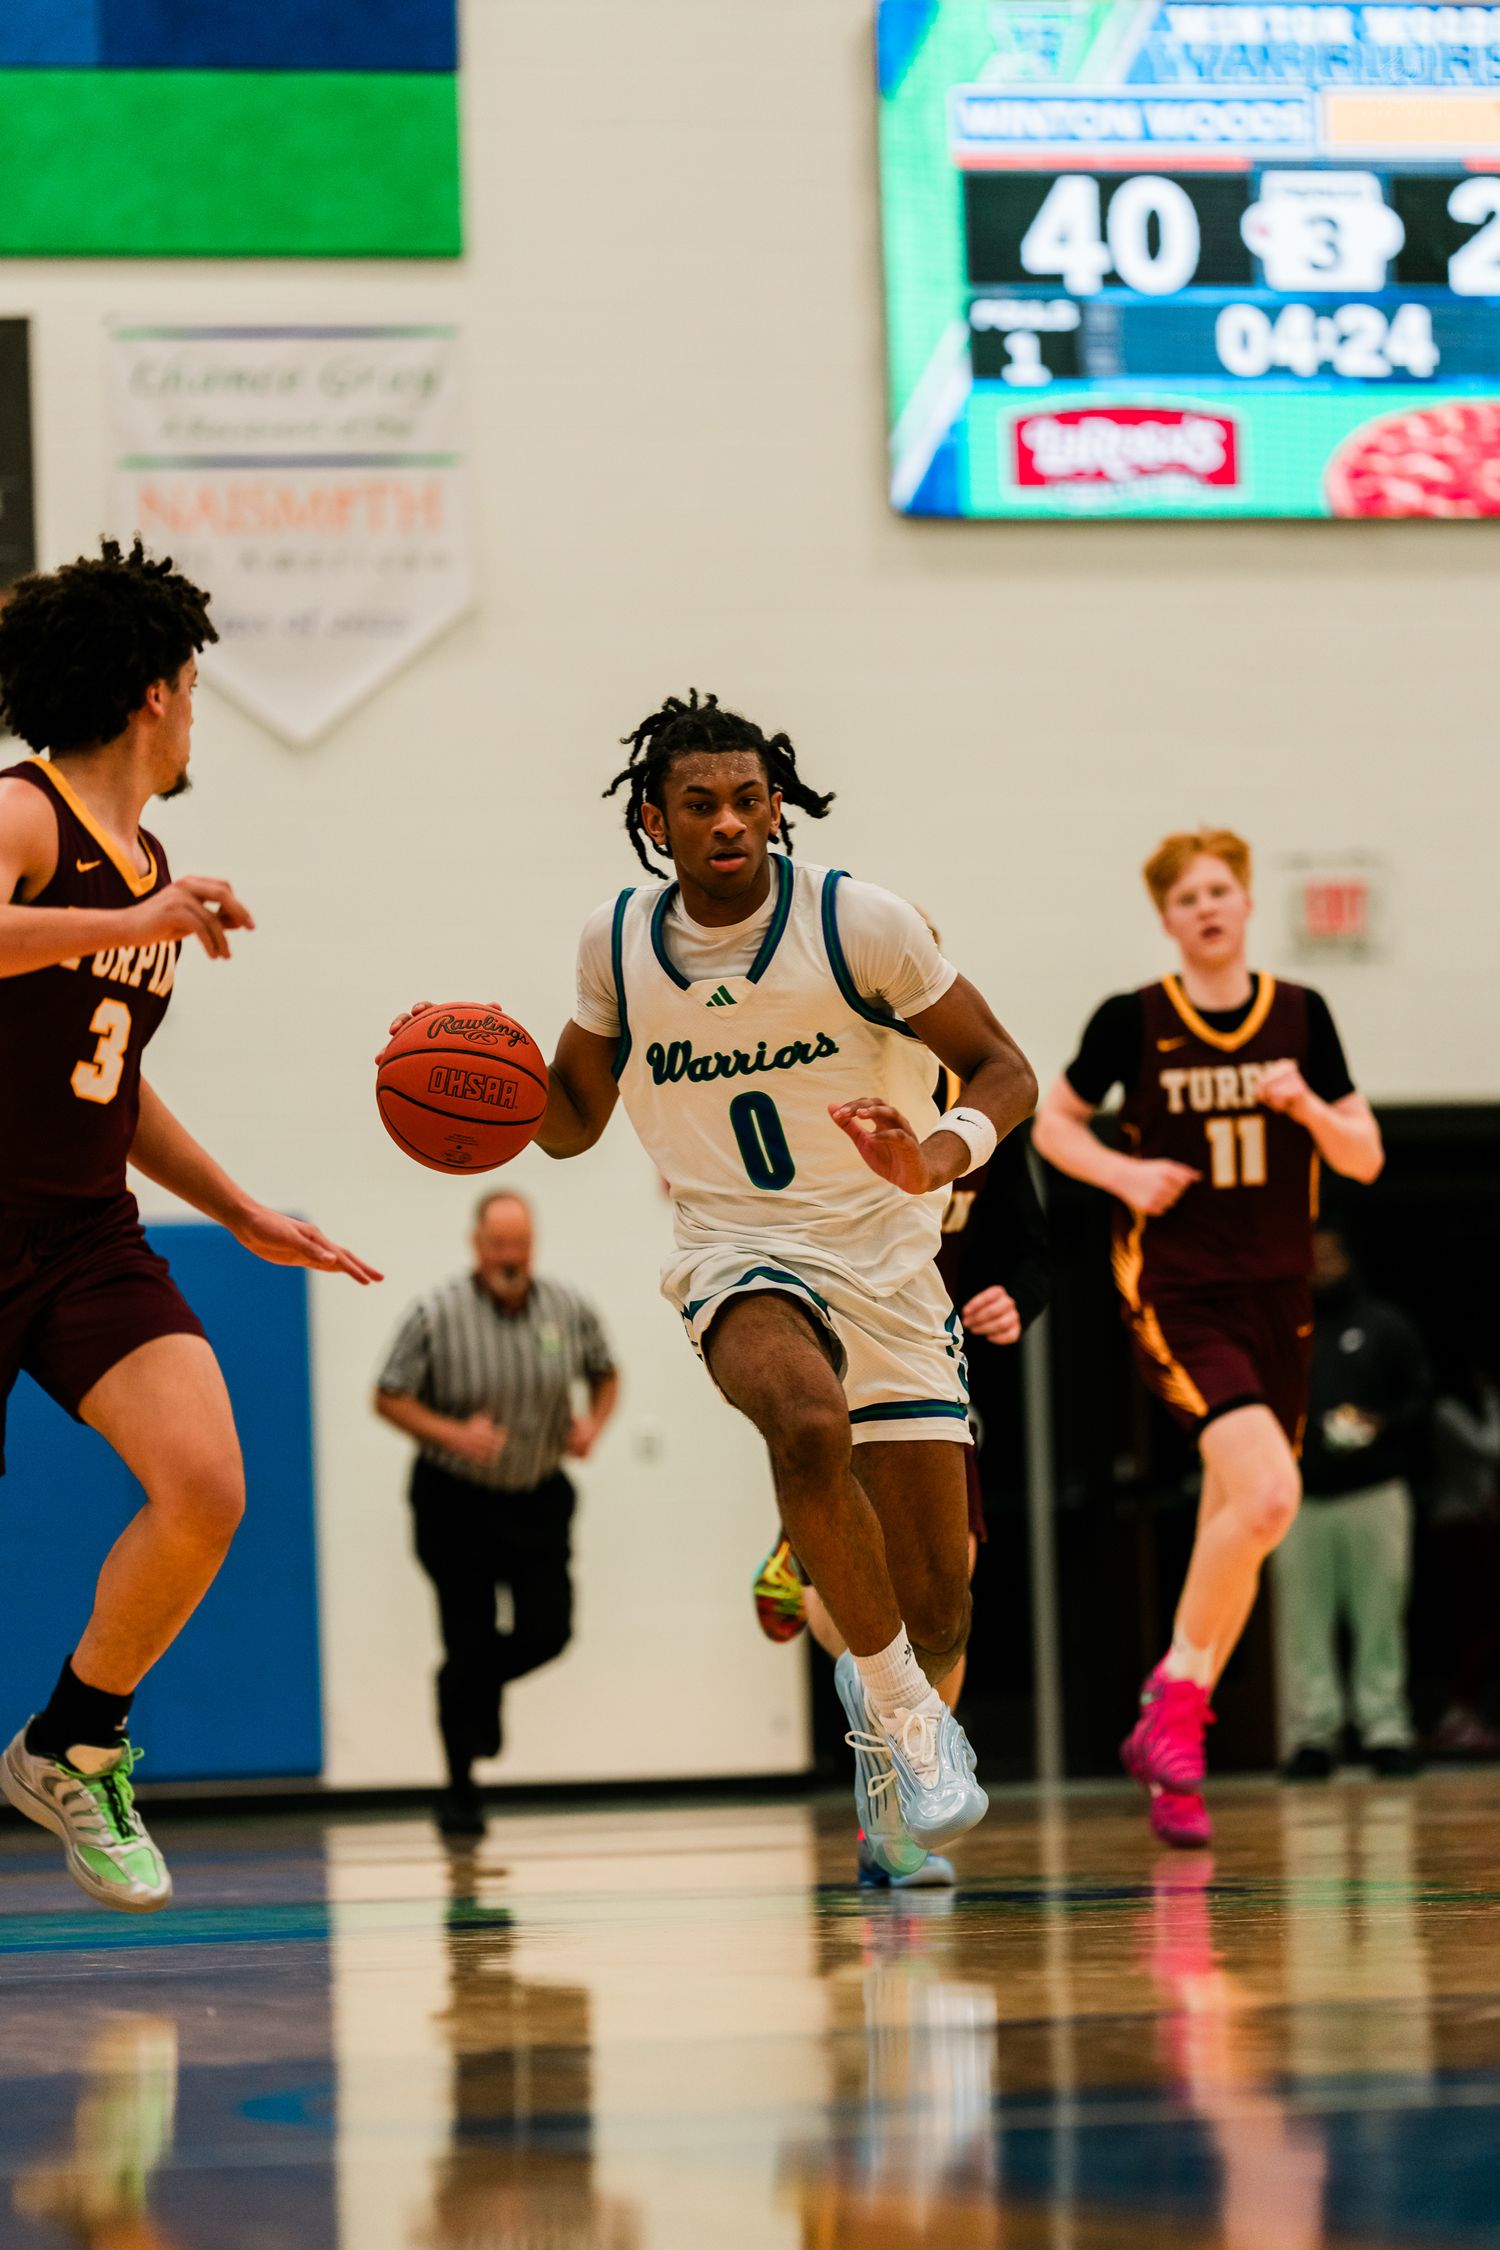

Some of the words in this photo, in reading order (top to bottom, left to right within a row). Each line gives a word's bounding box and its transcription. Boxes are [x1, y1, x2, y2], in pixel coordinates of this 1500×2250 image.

[960, 101, 1141, 139] WINTON
[1020, 174, 1200, 296] 40
[1304, 213, 1342, 274] 3
[1002, 331, 1052, 387] 1
[1215, 303, 1440, 377] 04:24
[70, 997, 132, 1105] 3
[427, 1014, 530, 1048] Rawlings
[646, 1032, 839, 1085] Warriors
[427, 1065, 518, 1110] OHSAA
[1158, 1060, 1297, 1115] TURP
[729, 1091, 796, 1191] 0
[1204, 1114, 1267, 1189] 11
